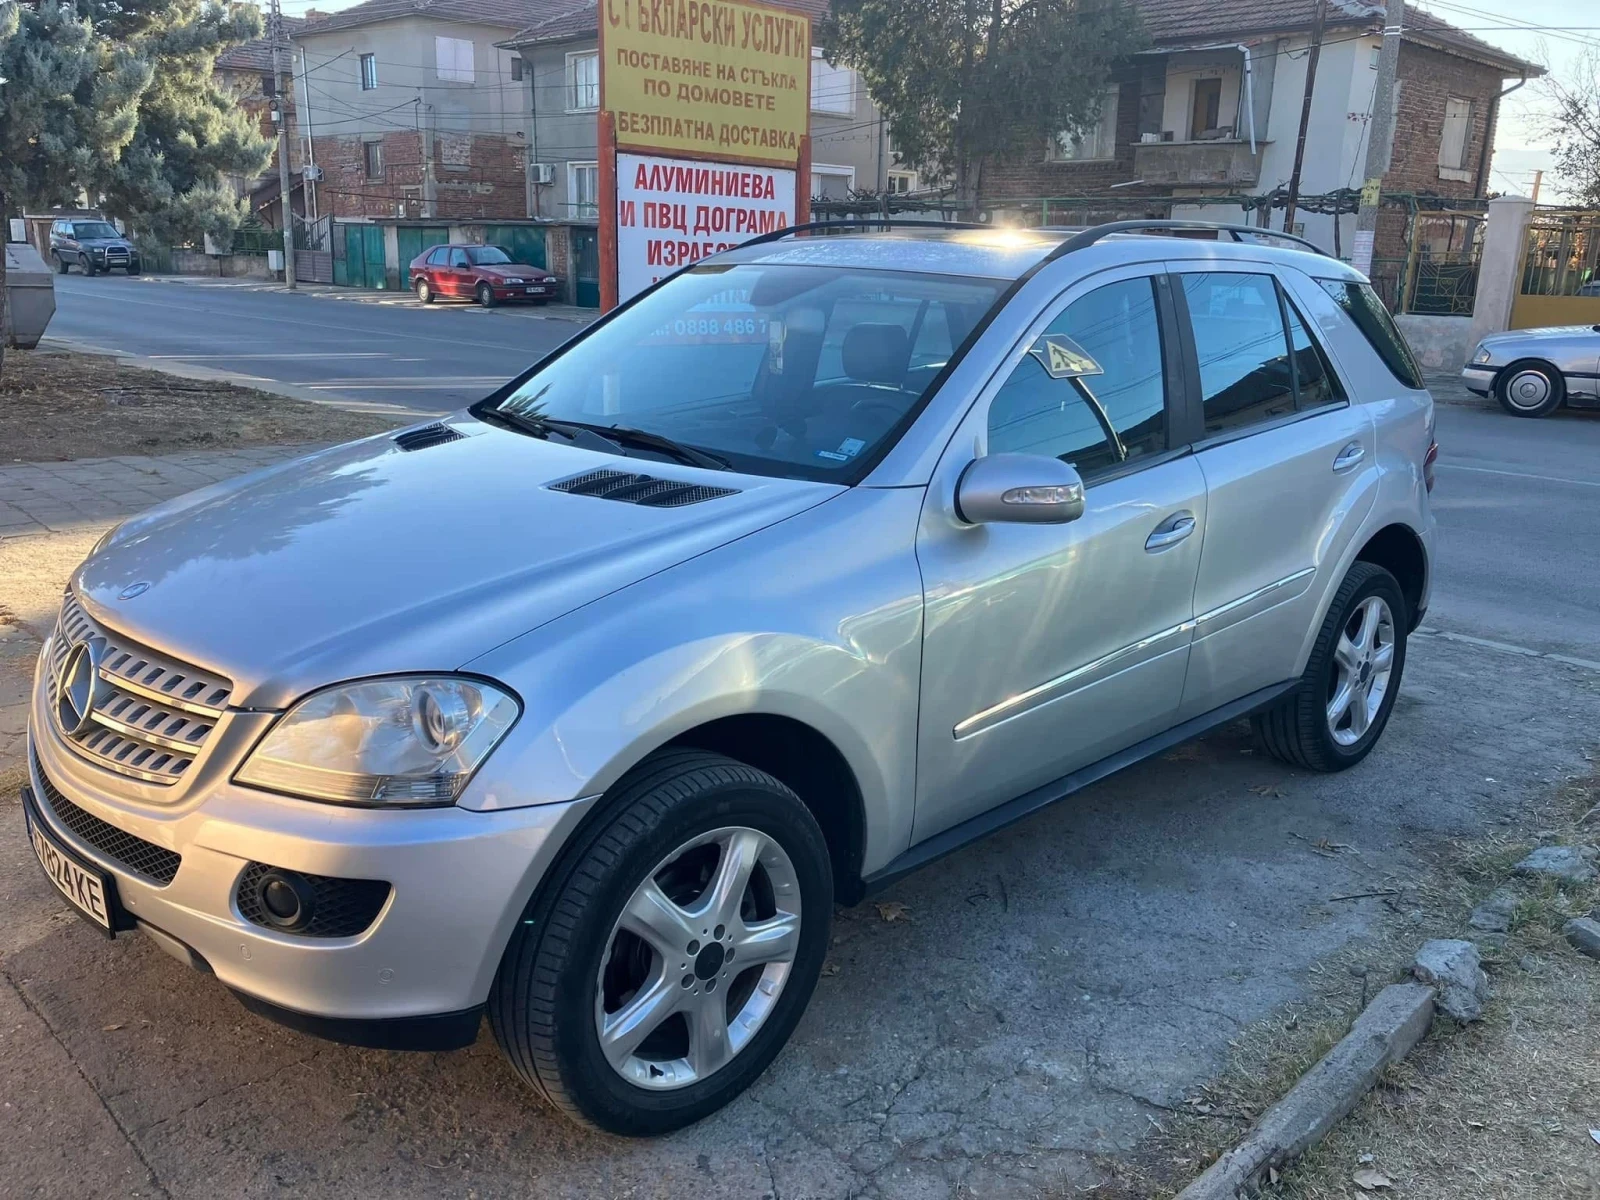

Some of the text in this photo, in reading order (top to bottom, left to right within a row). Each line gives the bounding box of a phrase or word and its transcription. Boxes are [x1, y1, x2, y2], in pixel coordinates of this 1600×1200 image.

[741, 12, 805, 59] УСЛУГИ
[617, 48, 797, 91] ПОСТАВЯНЕ НА СТЪКЛА
[643, 78, 776, 111] ПО ДОМОВЕТЕ
[618, 111, 796, 150] БЕЗПЛАТНА ДОСТАВКА
[634, 163, 775, 200] АЛУМИНИЕВА
[620, 200, 788, 236] И ПВЦ ДОГРАМА
[647, 239, 738, 267] ИЗРАБ
[674, 318, 719, 335] 0888
[723, 318, 755, 335] 486
